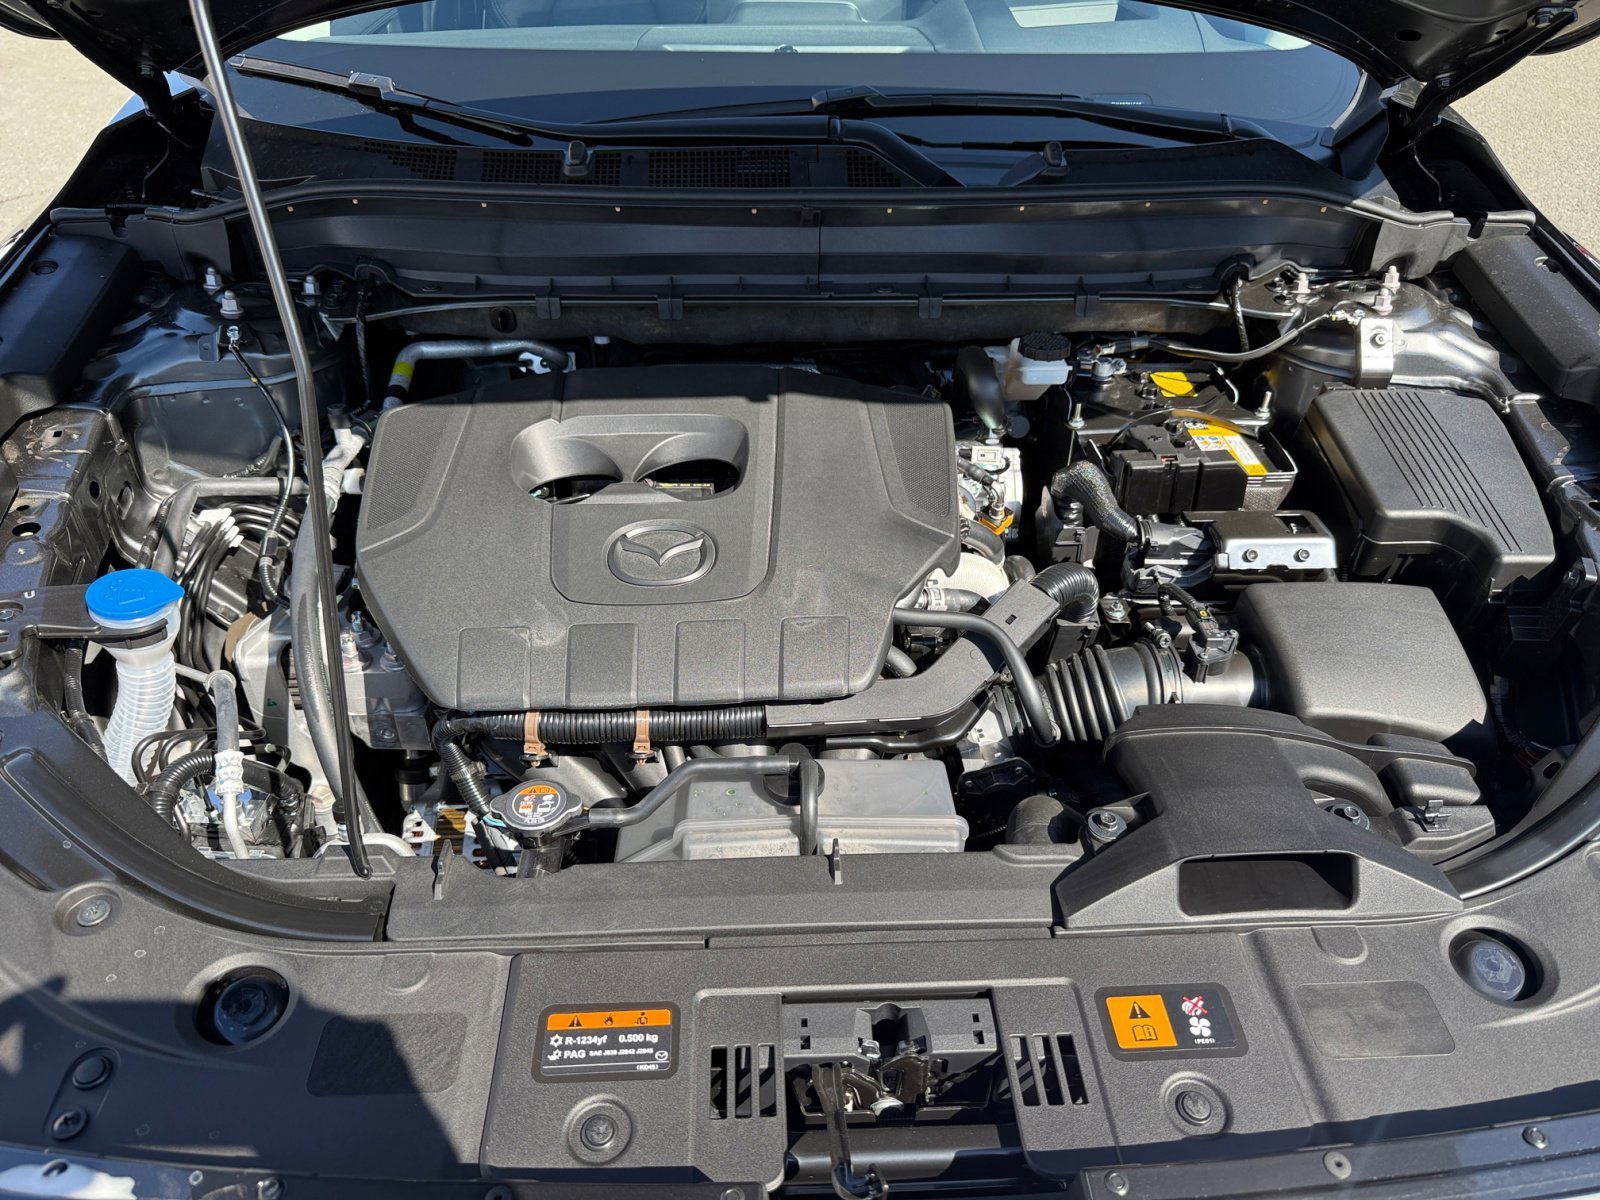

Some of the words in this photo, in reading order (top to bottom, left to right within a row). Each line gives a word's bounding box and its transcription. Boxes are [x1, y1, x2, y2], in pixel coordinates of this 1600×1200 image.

[565, 1035, 607, 1045] R-1234yf
[618, 1033, 645, 1043] 0.500
[646, 1033, 658, 1043] kg
[564, 1050, 586, 1059] PAG
